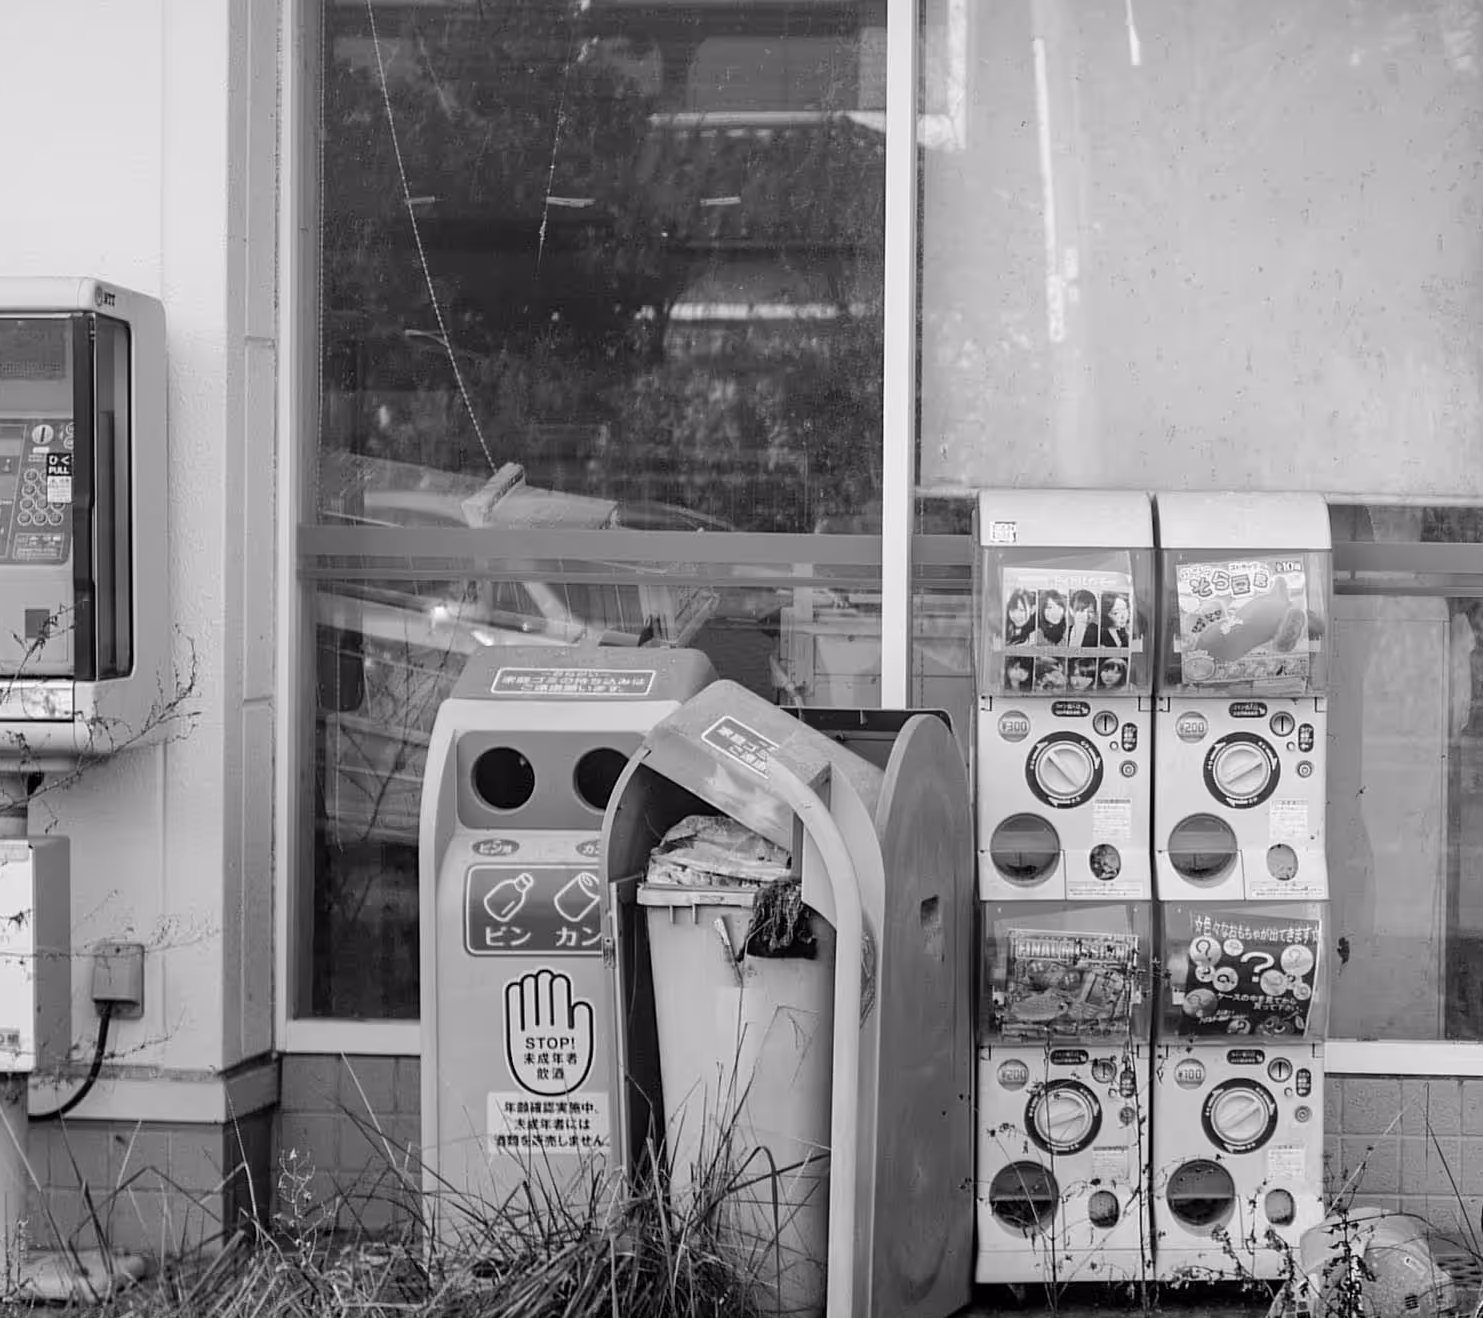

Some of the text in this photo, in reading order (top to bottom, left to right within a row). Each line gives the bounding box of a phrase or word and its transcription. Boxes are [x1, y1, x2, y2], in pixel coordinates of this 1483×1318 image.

[48, 465, 70, 475] PULL
[485, 926, 531, 947] ビン
[555, 927, 603, 947] カン
[525, 1037, 575, 1050] STOP!
